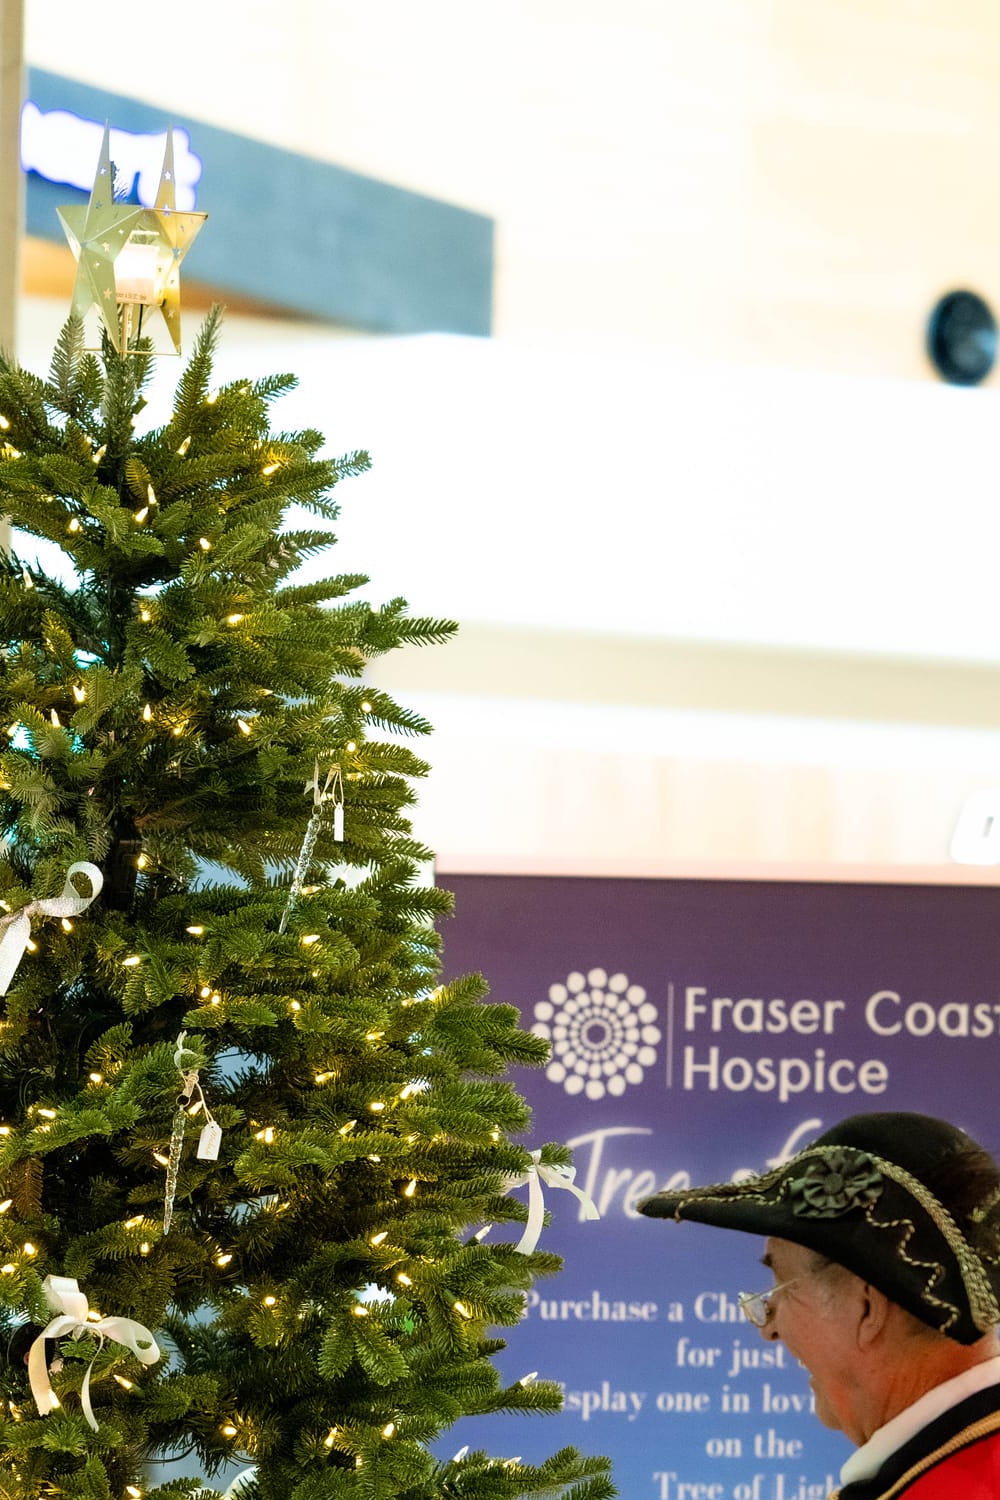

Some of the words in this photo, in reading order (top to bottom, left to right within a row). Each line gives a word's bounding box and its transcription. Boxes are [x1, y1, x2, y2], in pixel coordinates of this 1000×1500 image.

[685, 986, 846, 1035] Fraser
[865, 990, 1000, 1038] Coas
[683, 1045, 889, 1103] Hospice
[667, 1303, 684, 1323] a
[676, 1337, 721, 1368] for
[728, 1339, 787, 1378] just
[656, 1392, 711, 1413] one
[721, 1384, 751, 1413] in
[763, 1383, 816, 1414] lovi
[705, 1437, 742, 1459] on
[753, 1428, 804, 1459] the
